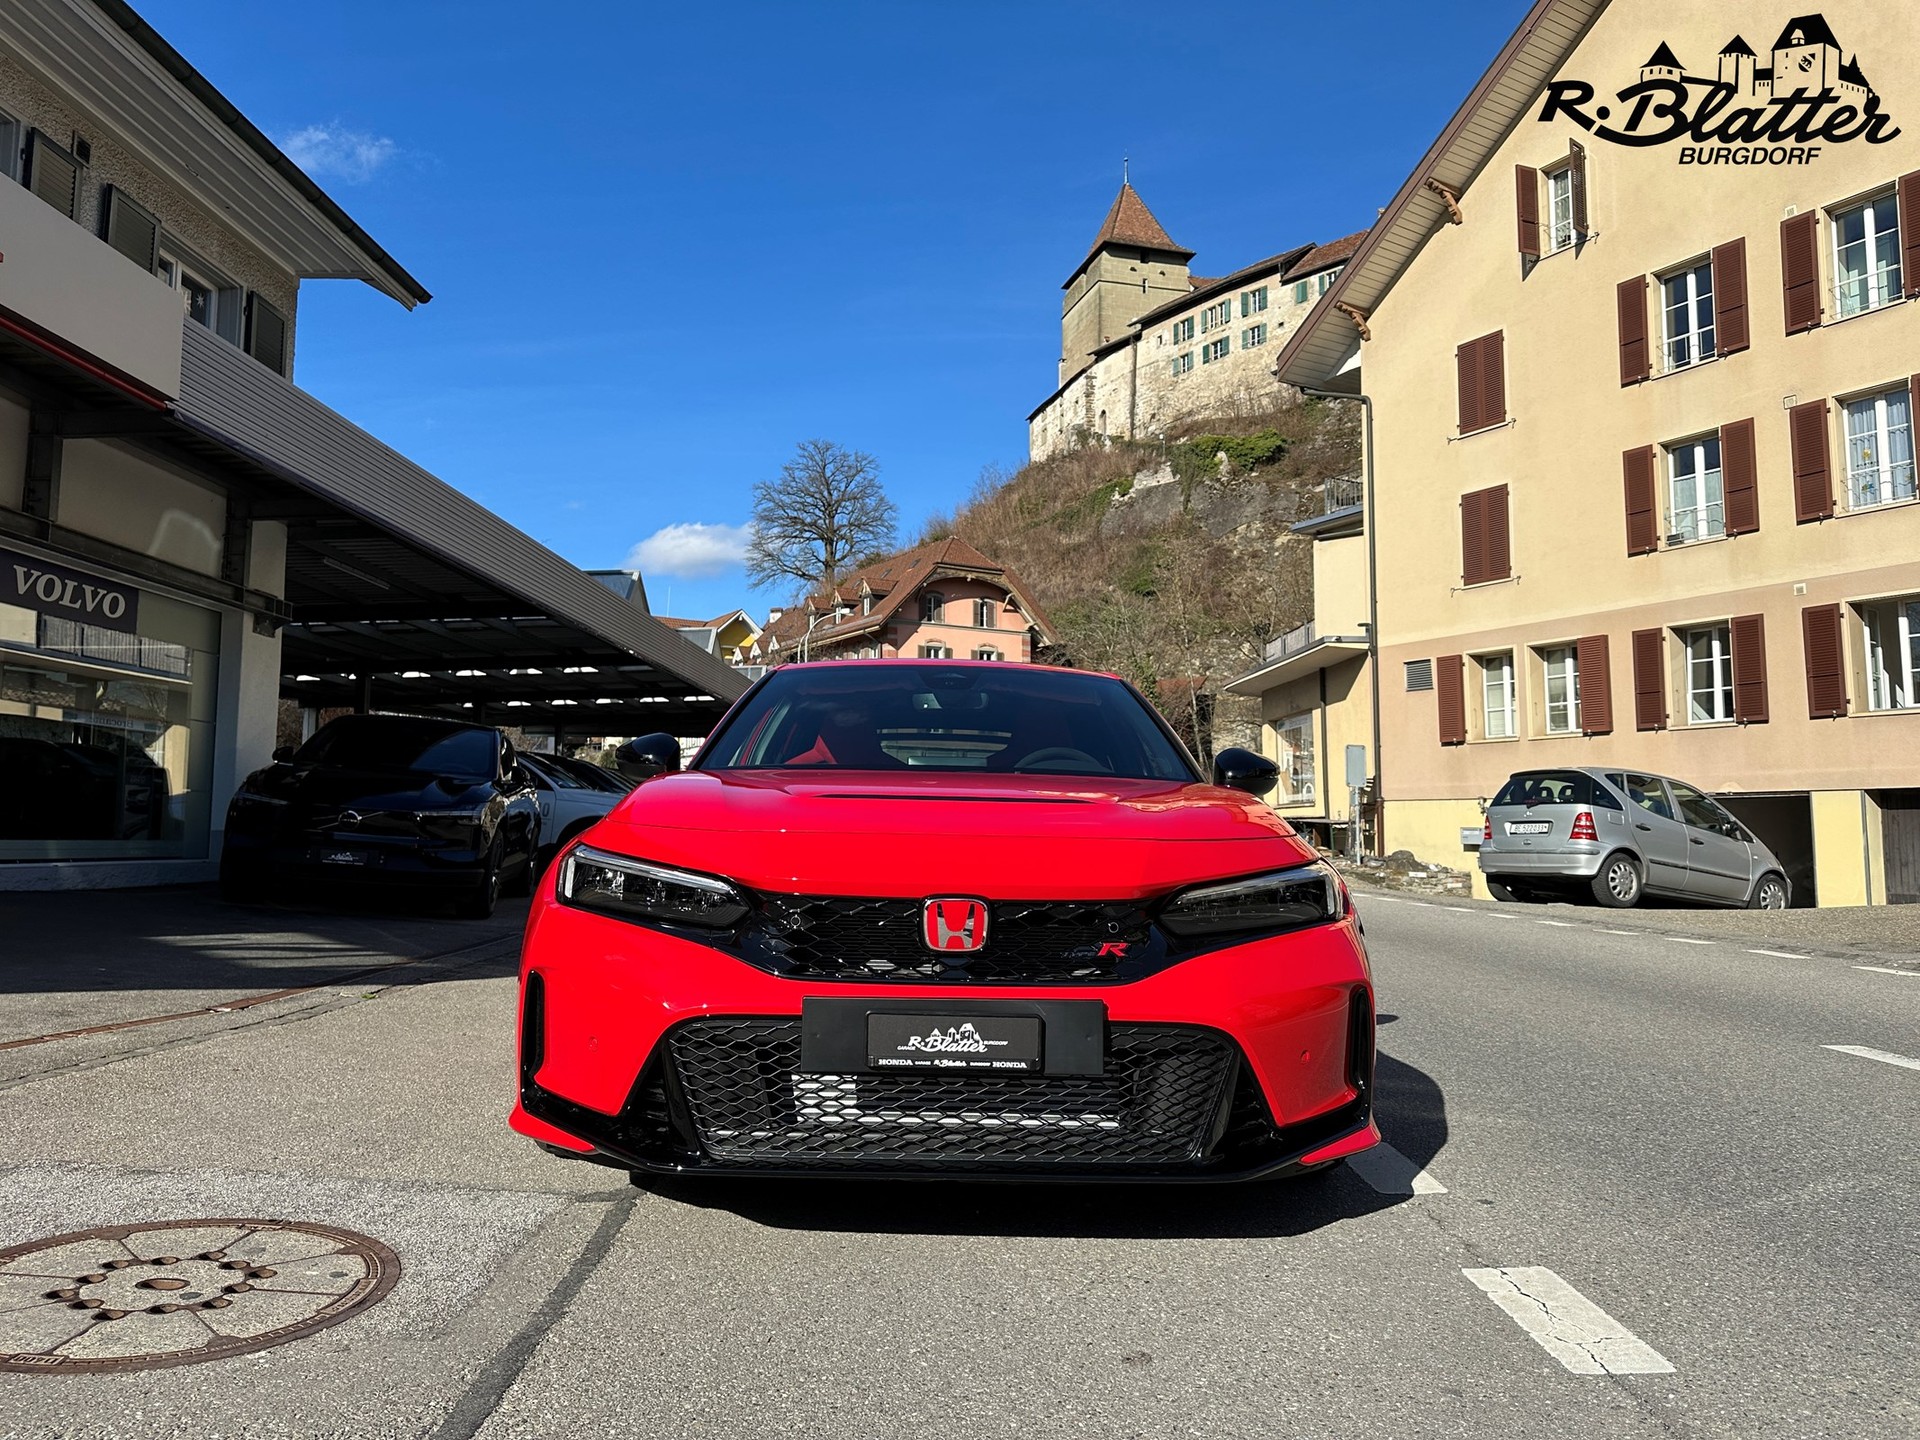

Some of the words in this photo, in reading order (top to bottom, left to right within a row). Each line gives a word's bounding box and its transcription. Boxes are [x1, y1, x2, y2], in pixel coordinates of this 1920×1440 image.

[13, 564, 126, 619] VOLVO
[1097, 942, 1129, 957] R
[878, 1058, 914, 1066] HONDA
[992, 1061, 1028, 1069] HONDA
